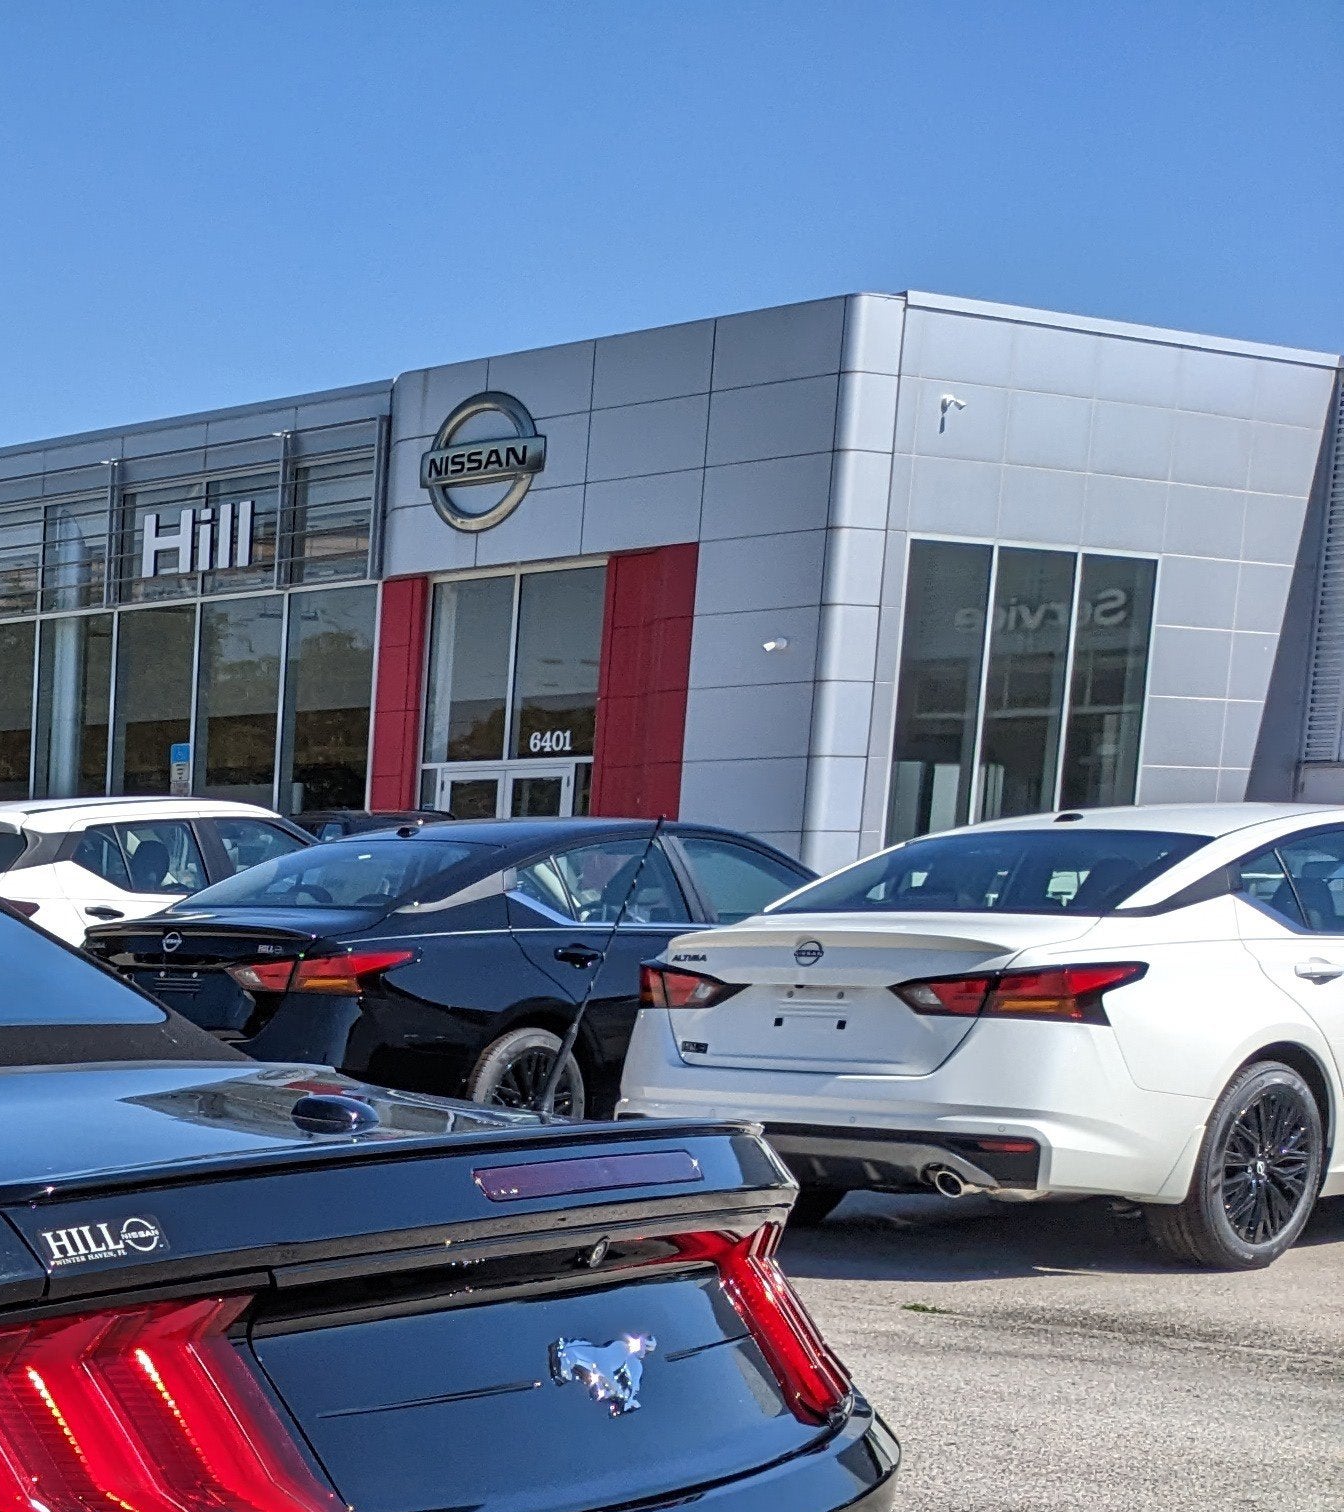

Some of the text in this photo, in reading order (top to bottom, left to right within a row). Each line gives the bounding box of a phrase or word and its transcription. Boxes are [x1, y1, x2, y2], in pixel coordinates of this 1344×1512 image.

[428, 445, 527, 478] NISSAN
[141, 501, 256, 578] Hill
[529, 729, 572, 752] 6401
[42, 1223, 159, 1259] HILL NISSAN
[56, 1255, 86, 1266] WINTER
